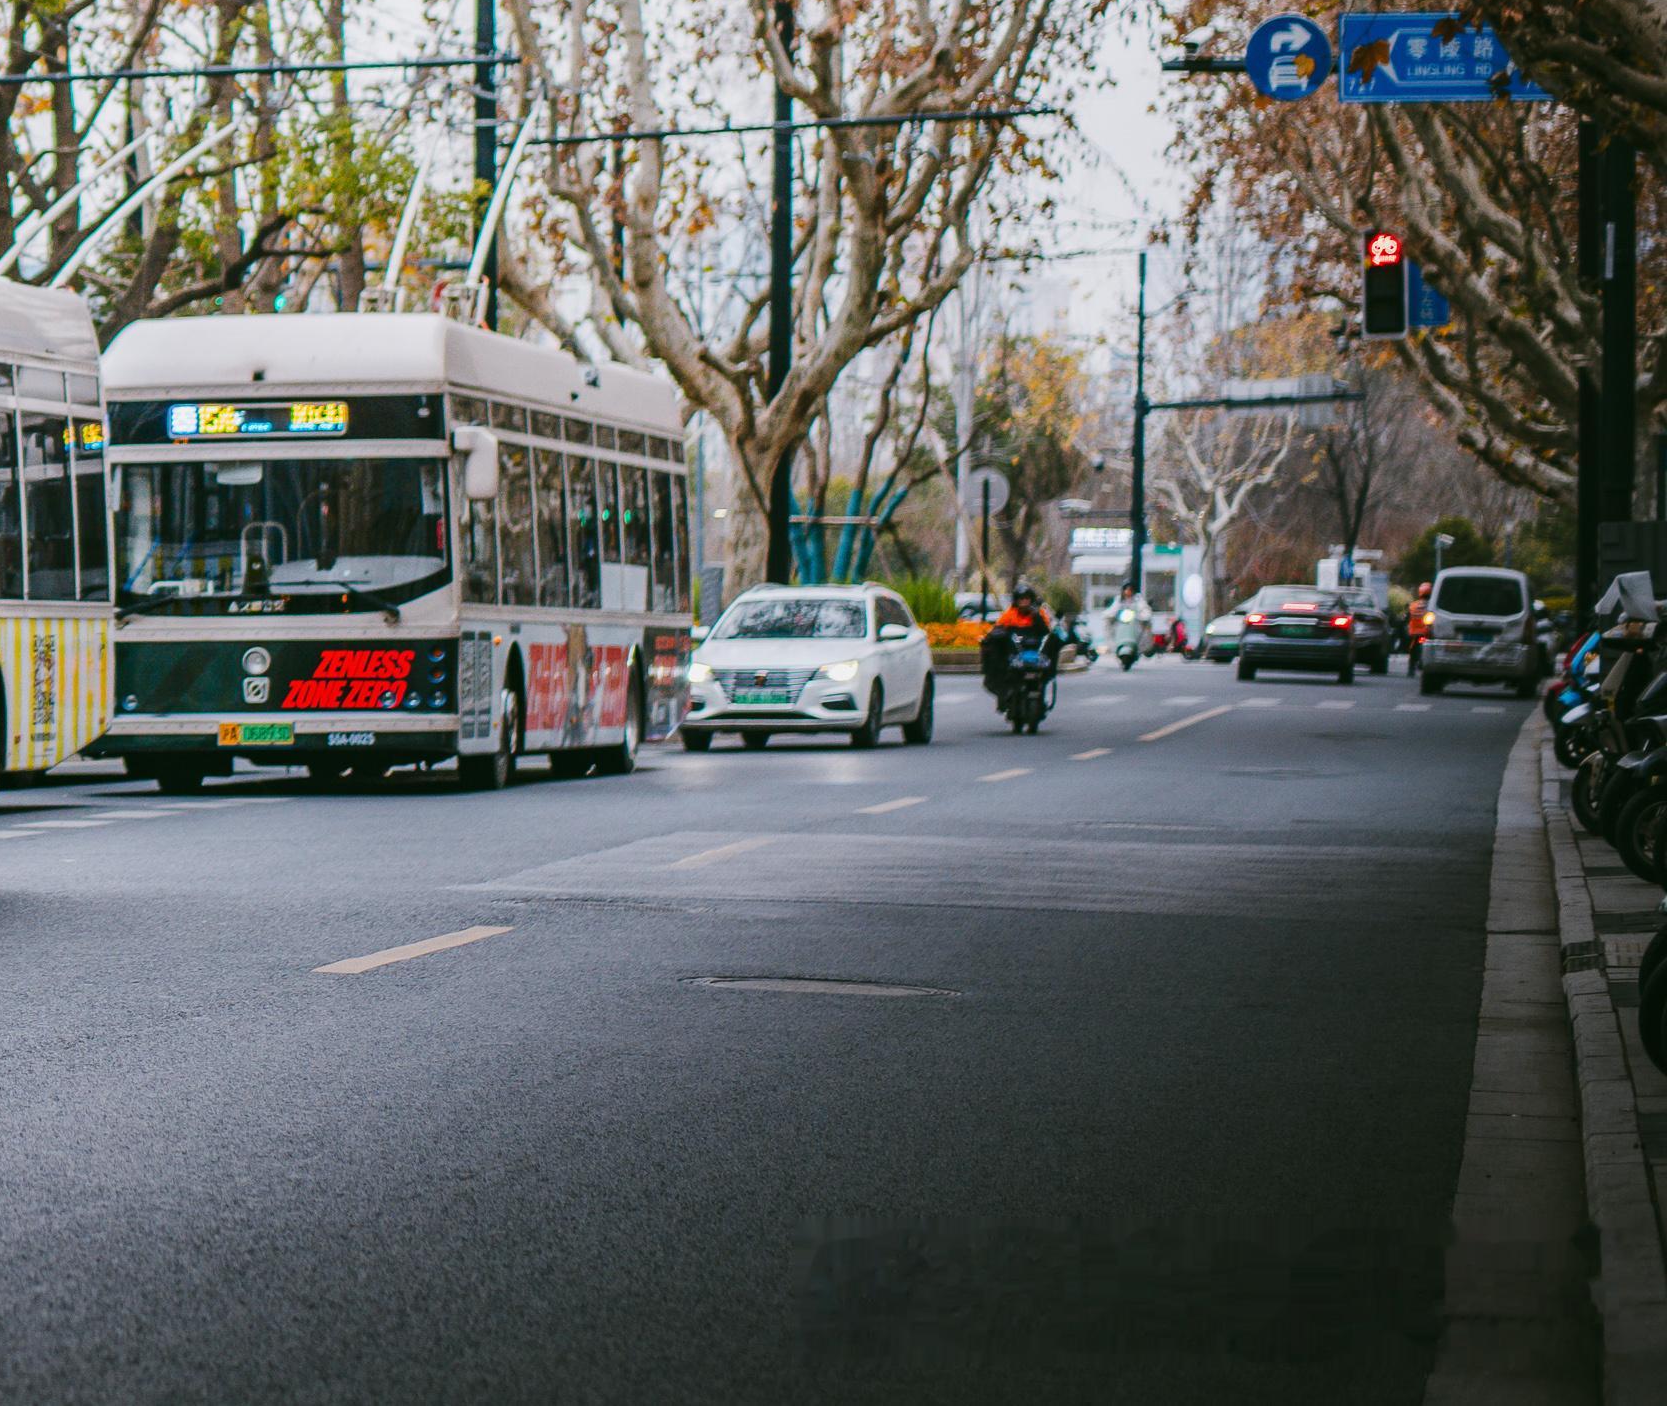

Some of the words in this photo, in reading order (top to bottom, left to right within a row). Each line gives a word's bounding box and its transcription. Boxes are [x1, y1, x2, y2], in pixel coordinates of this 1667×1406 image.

[312, 649, 416, 679] ZENLESS
[281, 679, 345, 709] ZONE
[341, 679, 408, 710] ZERO
